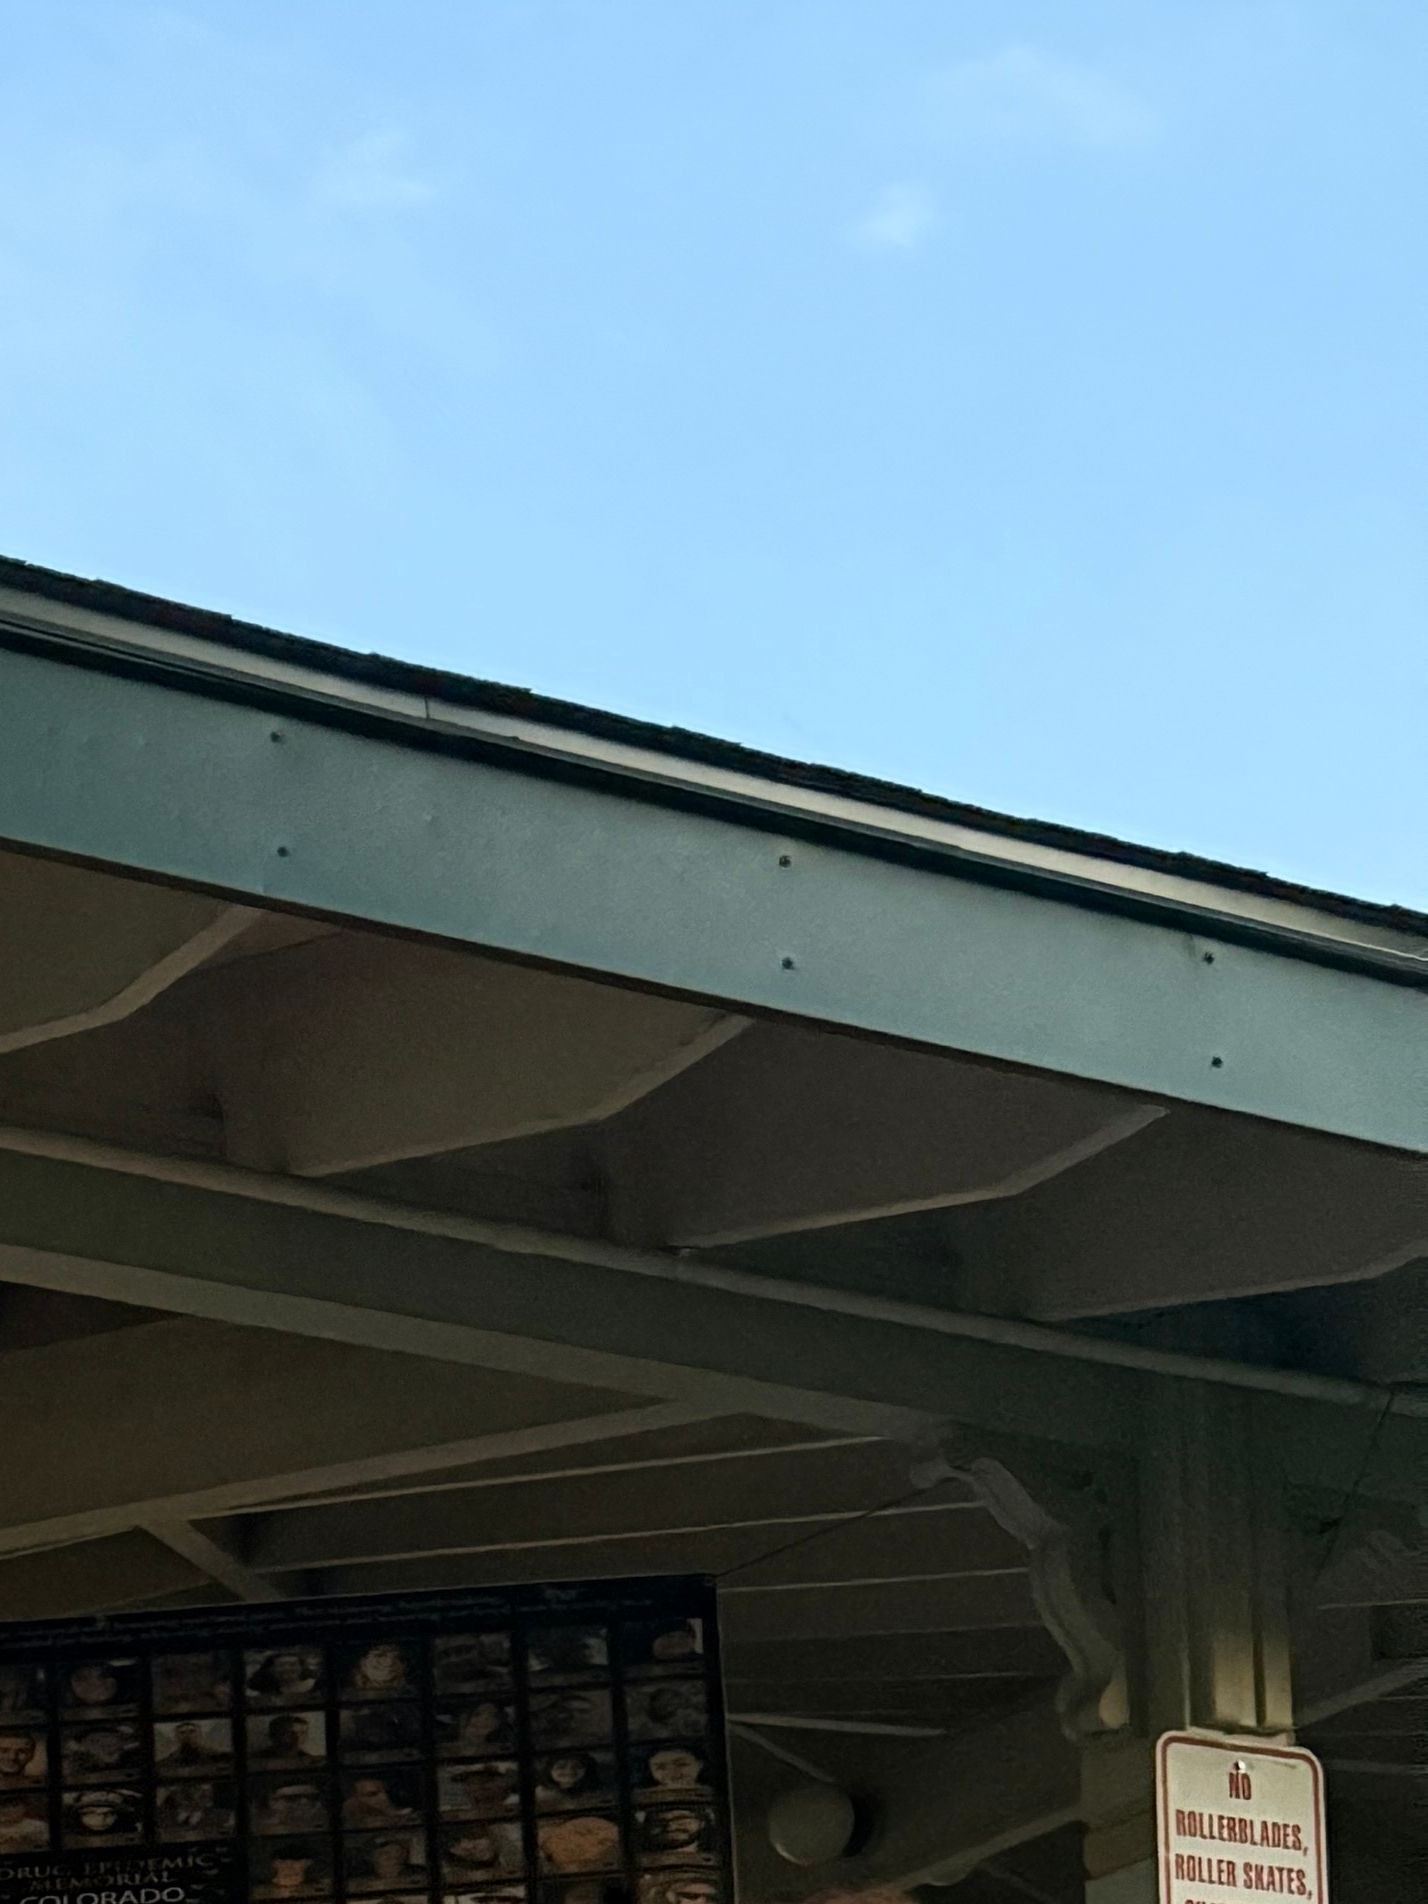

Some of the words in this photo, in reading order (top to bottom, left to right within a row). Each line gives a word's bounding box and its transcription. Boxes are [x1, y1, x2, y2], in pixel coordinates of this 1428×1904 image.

[1229, 1772, 1251, 1800] NO
[1175, 1809, 1309, 1856] ROLLERBLADES,
[1175, 1853, 1237, 1888] ROLLER
[1243, 1862, 1312, 1900] SKATES,
